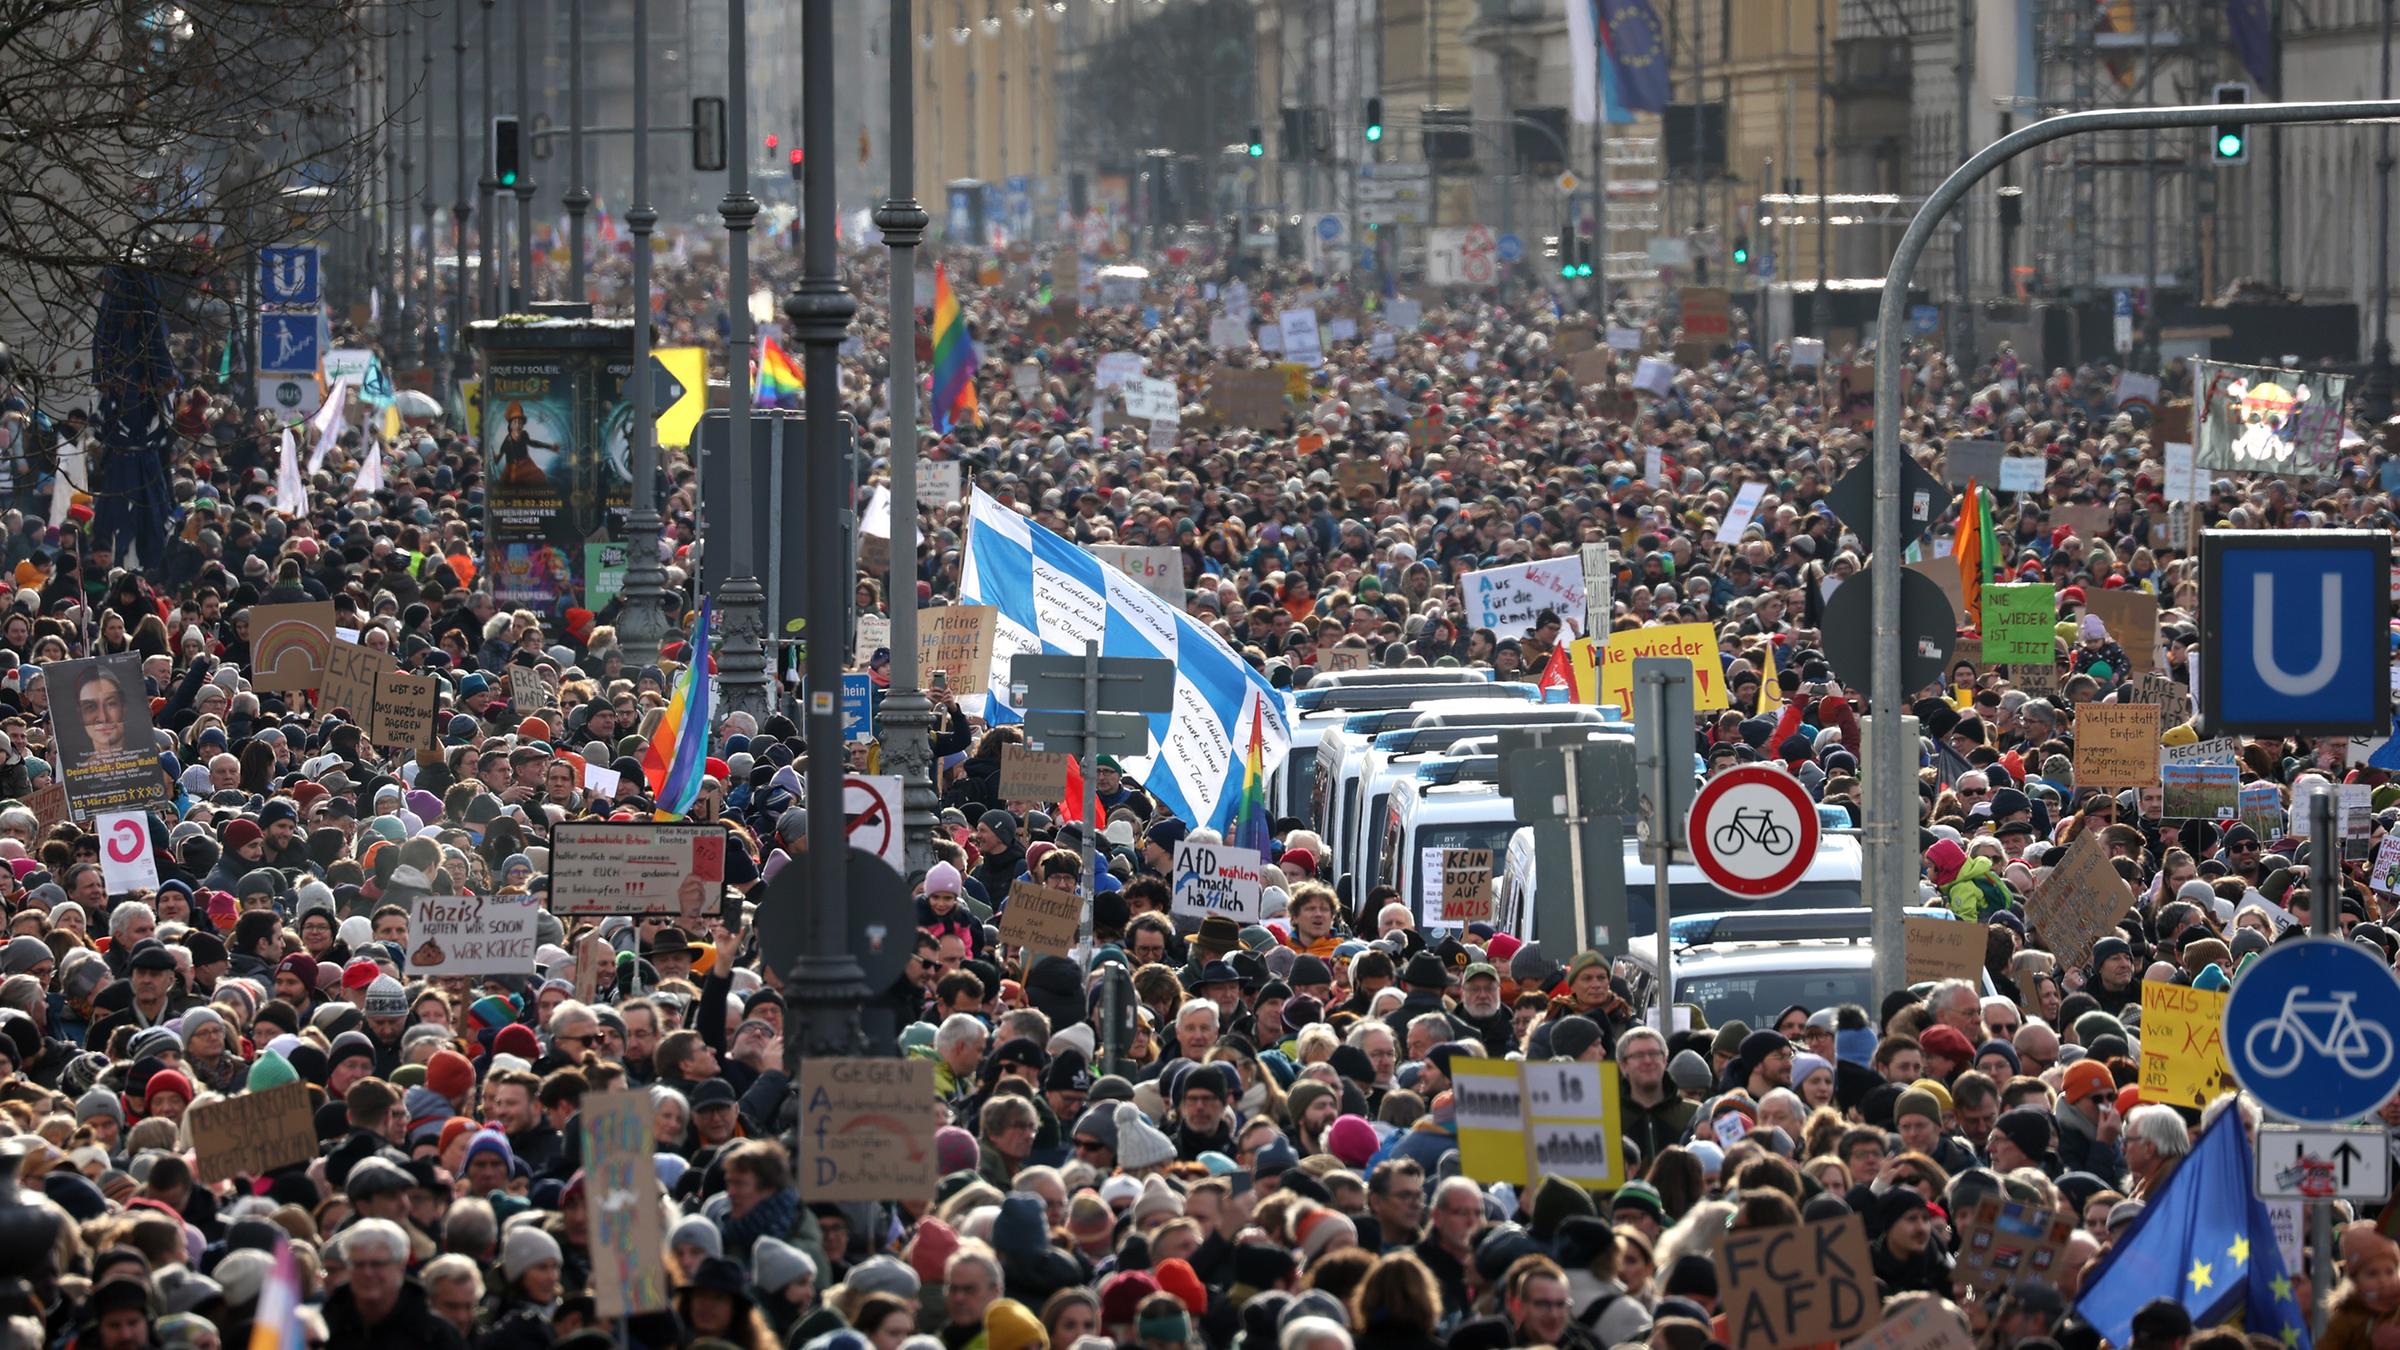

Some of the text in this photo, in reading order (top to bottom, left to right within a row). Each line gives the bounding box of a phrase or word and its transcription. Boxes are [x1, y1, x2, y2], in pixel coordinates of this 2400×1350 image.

[273, 254, 305, 296] U
[277, 388, 300, 400] BUS
[1480, 576, 1511, 592] Aus
[1036, 586, 1072, 612] Renate
[1057, 580, 1103, 612] Karlstadt
[1482, 590, 1532, 610] für die
[1989, 594, 2010, 607] NIE
[934, 615, 979, 630] Meine
[1999, 612, 2048, 626] WIEDER
[922, 631, 980, 645] Heimat
[995, 621, 1019, 642] ophie
[1062, 620, 1088, 643] Valen
[1990, 629, 2008, 641] IST
[2253, 572, 2343, 695] U
[918, 645, 979, 664] st nicht
[1633, 636, 1703, 658] wieder
[2009, 642, 2048, 654] JETZT
[514, 670, 539, 688] EKEL
[2142, 674, 2175, 697] MAKE
[412, 683, 426, 695] SO
[375, 701, 392, 712] DASS
[1179, 688, 1228, 759] Erich Mühsam
[2085, 711, 2126, 725] Vielfalt
[1180, 715, 1220, 774] Kurt Eisner
[2170, 738, 2234, 759] RECHTER
[66, 767, 89, 777] Deine
[90, 764, 114, 773] Stadt.
[115, 761, 137, 771] Deine
[1173, 734, 1211, 804] Ernst Toller
[2082, 768, 2100, 776] und
[676, 827, 699, 836] Karte
[1177, 847, 1216, 876] AfD
[1446, 852, 1488, 868] KEIN
[593, 866, 621, 878] EUCH
[1218, 865, 1259, 882] wählen
[1446, 871, 1488, 885] BOCK
[1197, 878, 1233, 893] macht
[1452, 885, 1480, 898] AUF
[419, 897, 483, 923] Nazis?
[1444, 900, 1489, 919] NAZIS
[466, 923, 485, 934] WIR
[2145, 986, 2199, 1013] NAZIS
[2181, 1021, 2224, 1059] KA
[831, 1062, 914, 1084] GEGEN
[1723, 1223, 1857, 1288] FCK
[1739, 1276, 1866, 1350] AFD
